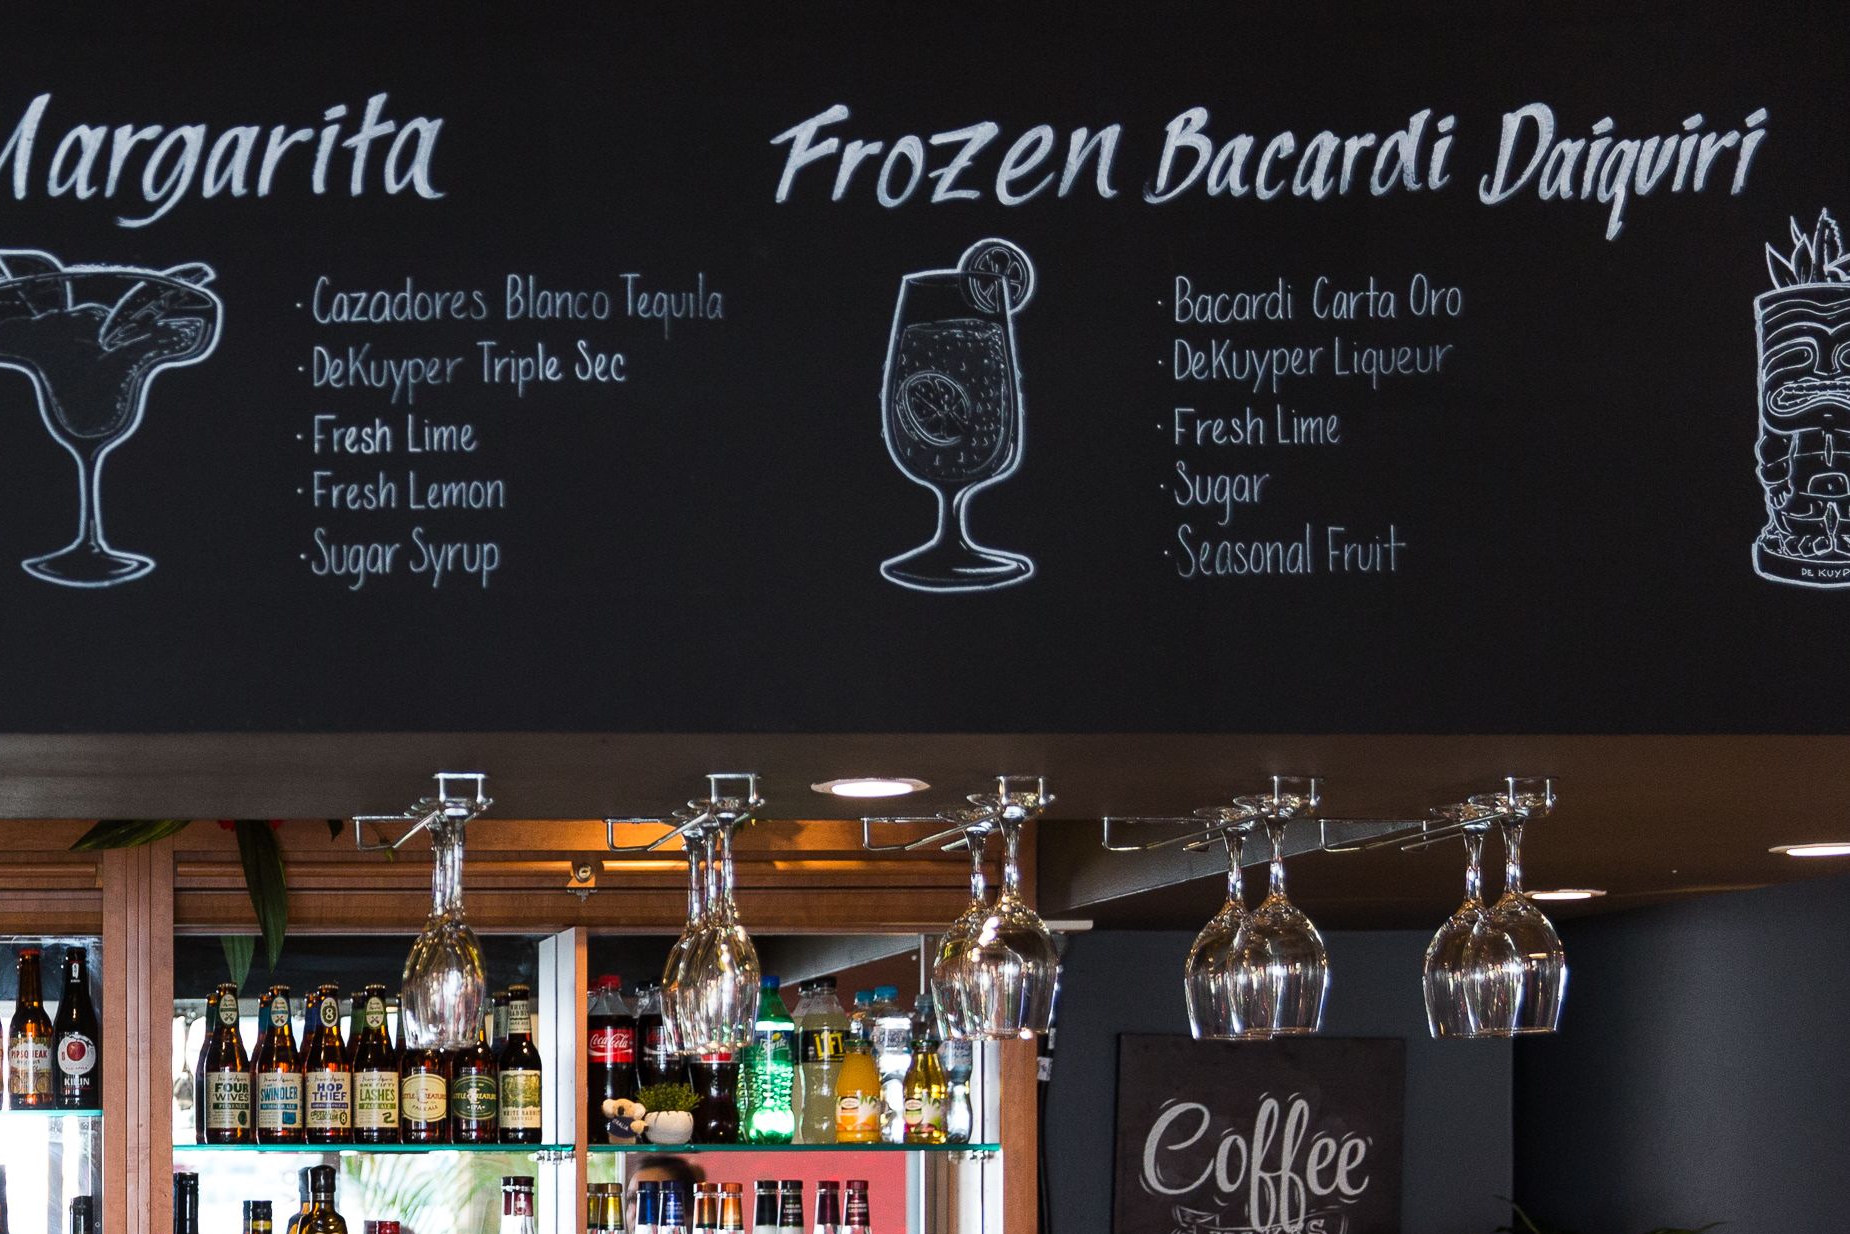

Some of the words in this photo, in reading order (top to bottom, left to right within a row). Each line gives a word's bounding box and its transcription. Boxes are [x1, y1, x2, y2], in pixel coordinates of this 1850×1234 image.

[769, 103, 1123, 209] Frozen
[1143, 105, 1457, 205] Bacardi
[1478, 101, 1770, 241] Daiquiri
[312, 275, 488, 325] Cazadores
[506, 273, 610, 320] Blanco
[619, 272, 723, 339] Tequila
[1175, 275, 1293, 324] Bacardi
[1312, 276, 1397, 320] Carta
[1409, 273, 1462, 316] Oro
[313, 343, 463, 404] DeKuyper
[476, 340, 564, 397] Triple
[574, 339, 626, 382] Sec
[1174, 338, 1324, 394] DeKuyper
[1334, 336, 1453, 390] Liqueur
[314, 413, 393, 455] Fresh
[407, 413, 478, 453] Lime
[1174, 406, 1265, 446] Fresh
[1276, 404, 1340, 444] Lime
[313, 470, 397, 510] Fresh
[409, 470, 505, 510] Lemon
[1174, 460, 1270, 526] Sugar
[311, 527, 401, 591] Sugar
[409, 526, 500, 588] Syrup
[1177, 523, 1312, 578] Seasonal
[1328, 524, 1406, 572] Fruit
[814, 1032, 844, 1056] LIFT
[215, 1083, 248, 1093] FOUR
[312, 1092, 347, 1101] THIEF
[317, 1083, 343, 1092] HOP
[359, 1088, 396, 1101] LASHES
[1142, 1098, 1370, 1232] Coffee
